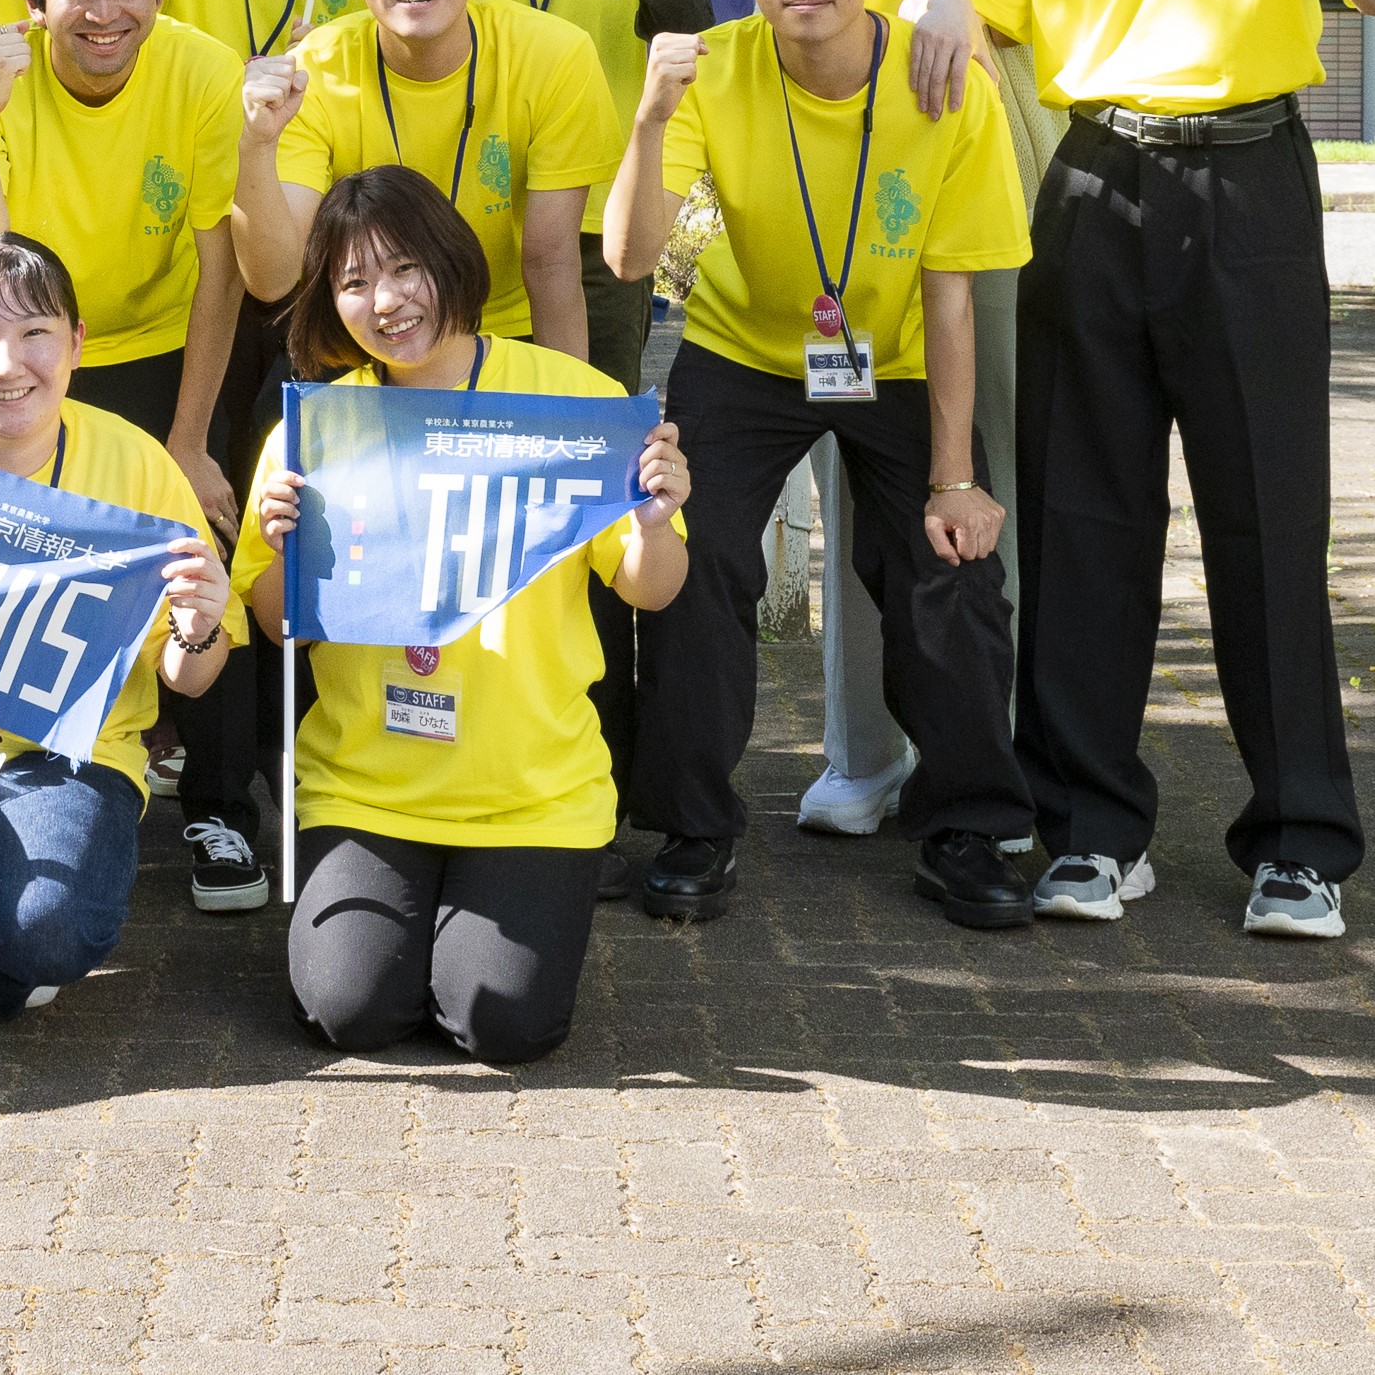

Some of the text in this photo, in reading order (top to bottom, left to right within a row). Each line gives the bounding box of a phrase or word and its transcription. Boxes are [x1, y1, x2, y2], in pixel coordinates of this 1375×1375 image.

[485, 201, 511, 214] STA
[870, 243, 916, 258] STAFF
[813, 309, 837, 322] STAFF
[831, 354, 854, 367] STA
[425, 417, 459, 427] 学校法人
[423, 431, 607, 461] 東京情報大学
[412, 691, 446, 708] STAFF
[419, 715, 449, 730] ひなた
